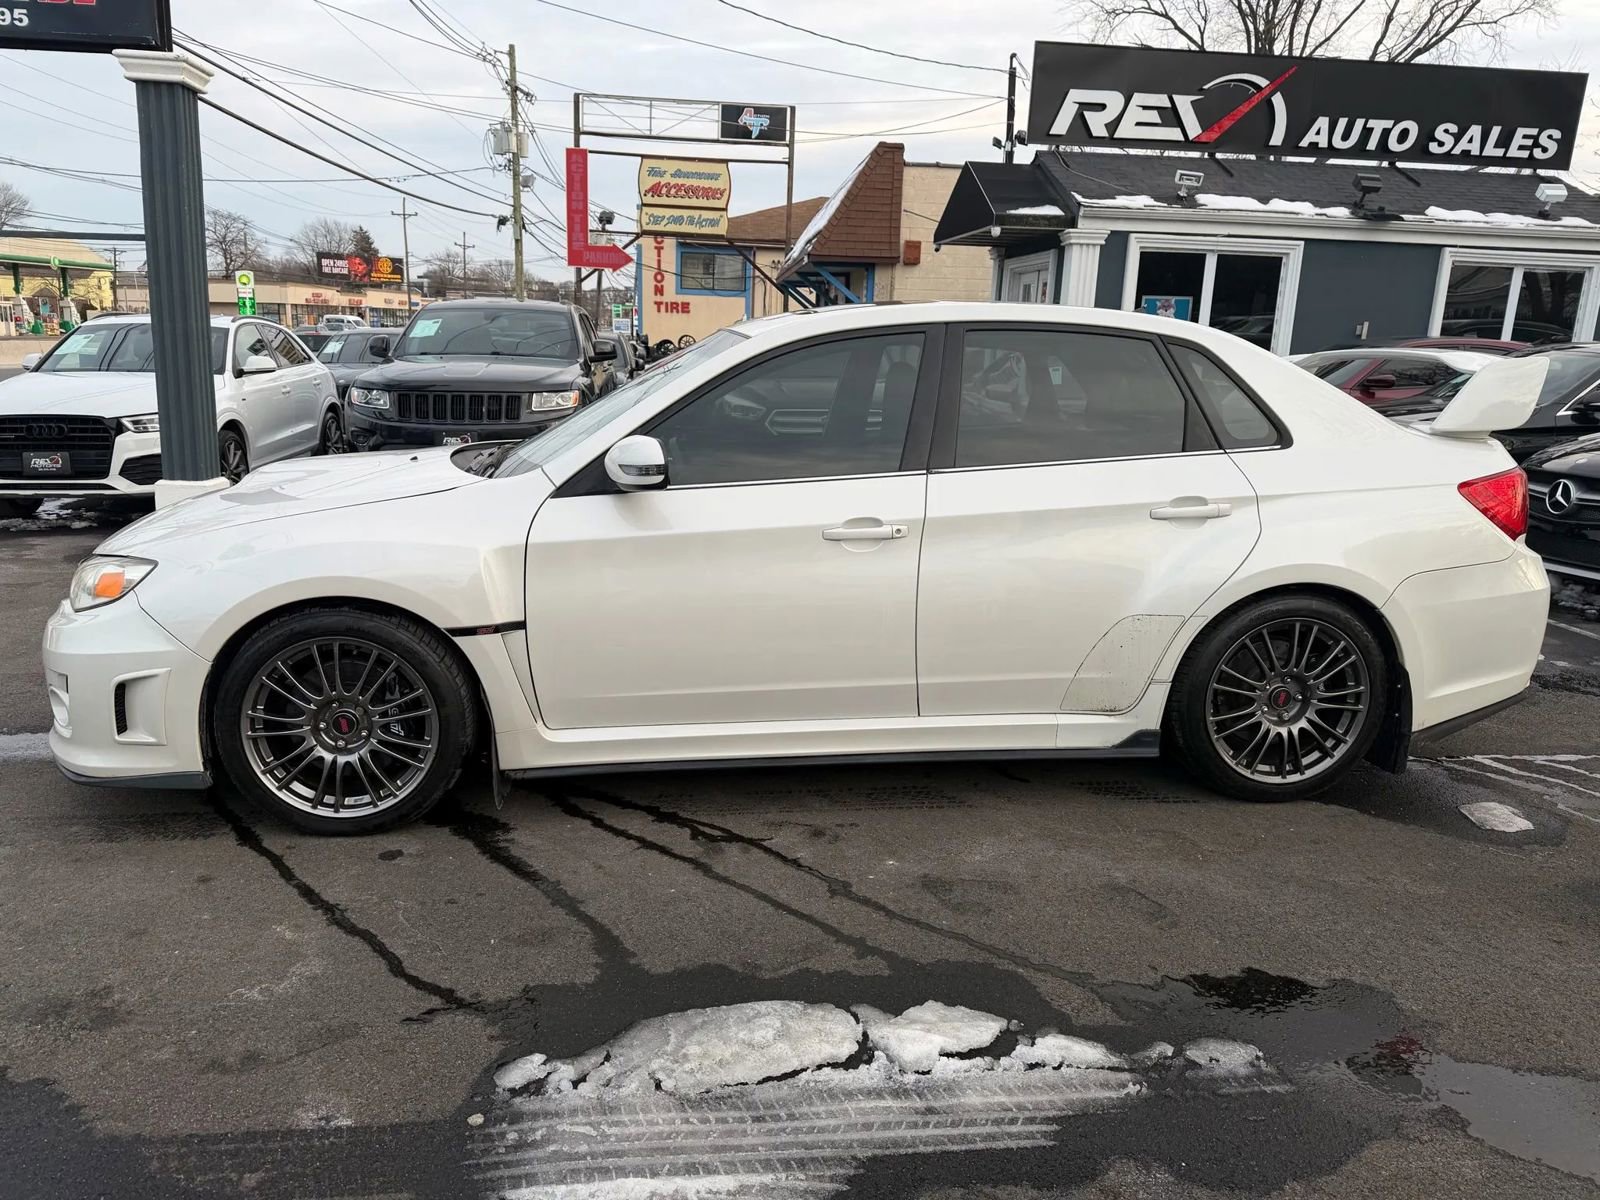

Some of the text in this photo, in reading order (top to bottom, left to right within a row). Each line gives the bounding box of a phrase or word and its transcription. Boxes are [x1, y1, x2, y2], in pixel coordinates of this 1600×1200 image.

[1298, 116, 1562, 160] AUTO SALES
[644, 181, 727, 200] ACCESSORIES
[654, 302, 691, 314] TIRE
